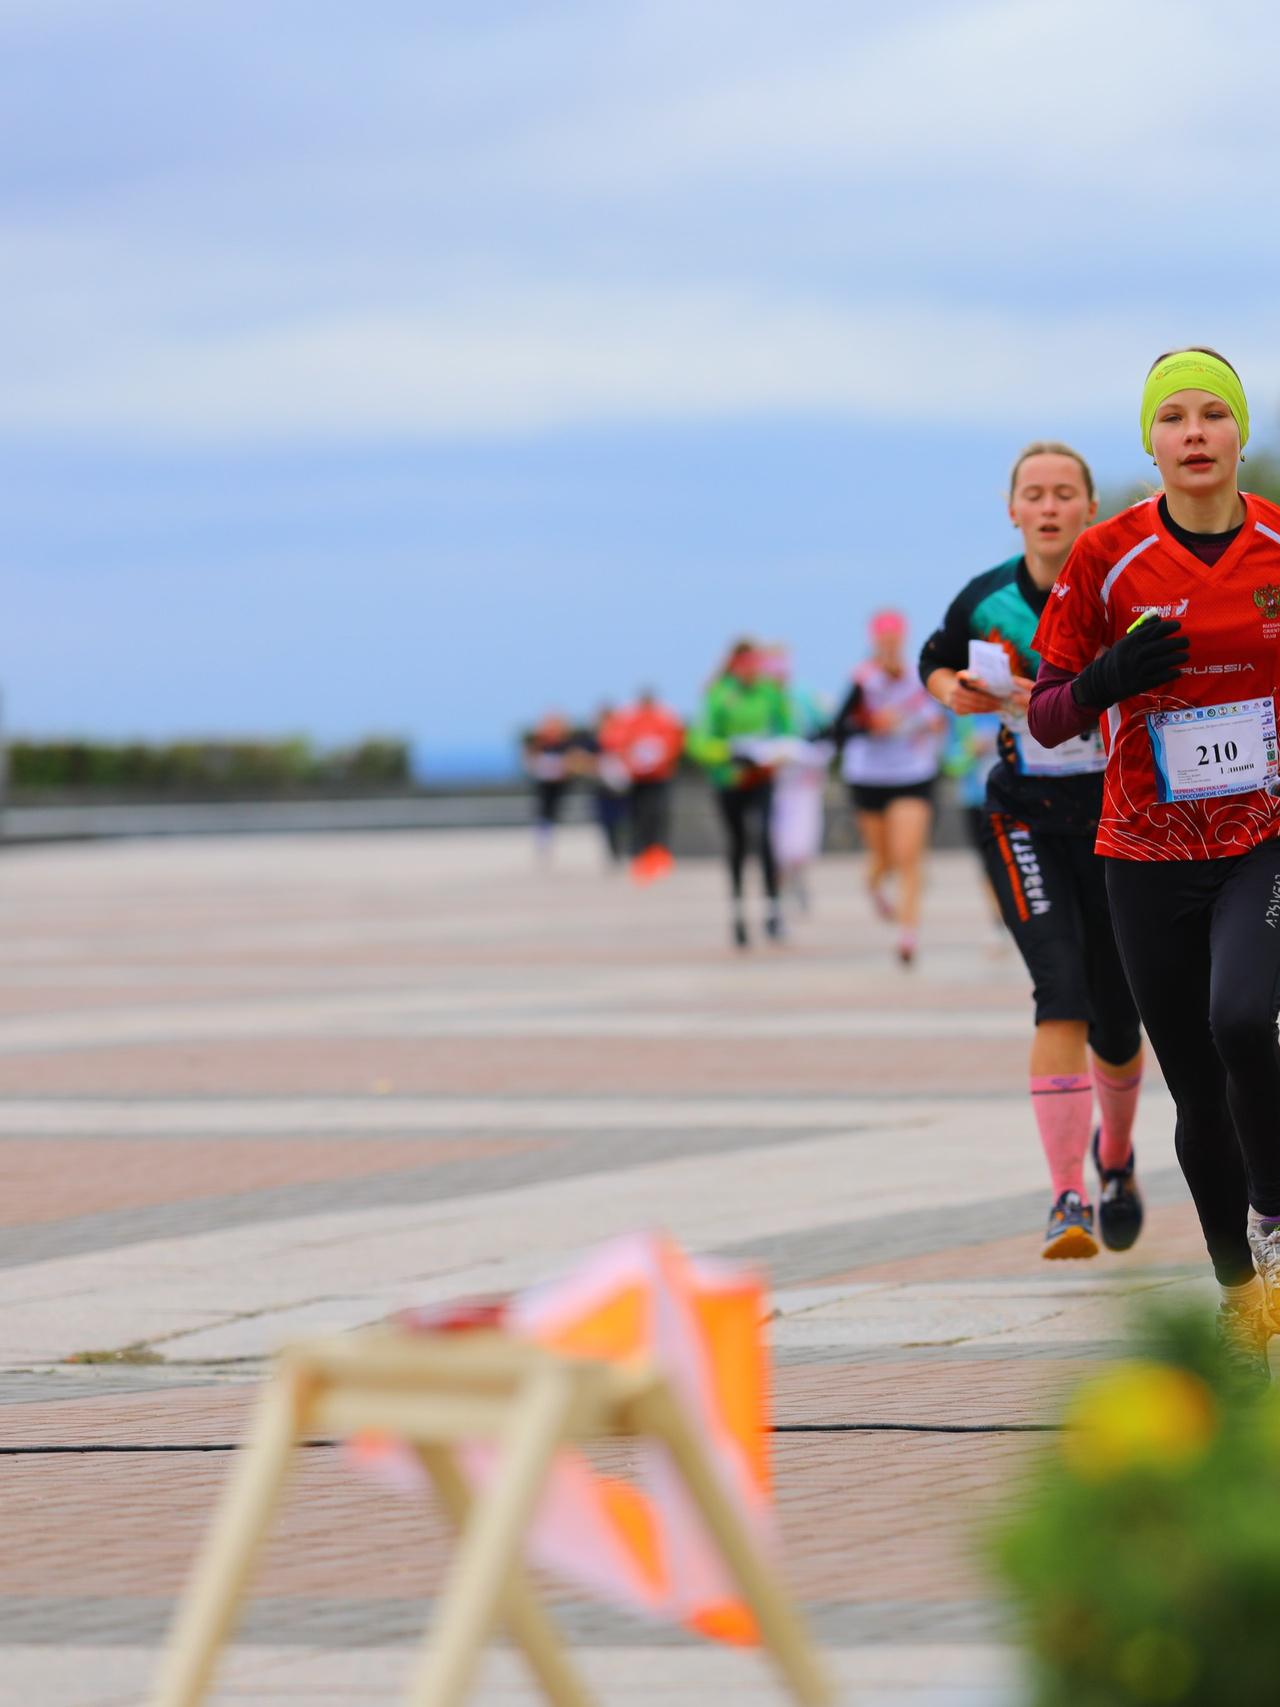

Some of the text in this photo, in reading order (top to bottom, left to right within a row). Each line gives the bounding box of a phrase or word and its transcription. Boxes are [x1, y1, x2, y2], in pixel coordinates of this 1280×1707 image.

[1180, 663, 1255, 675] RUSSIA
[1195, 740, 1238, 767] 210
[1172, 784, 1228, 795] ПЕРВЕНСТВО РОССИИ
[1173, 784, 1258, 801] ВСЕРОССИЙСКИЕ СОРЕВНОВАНИЯ
